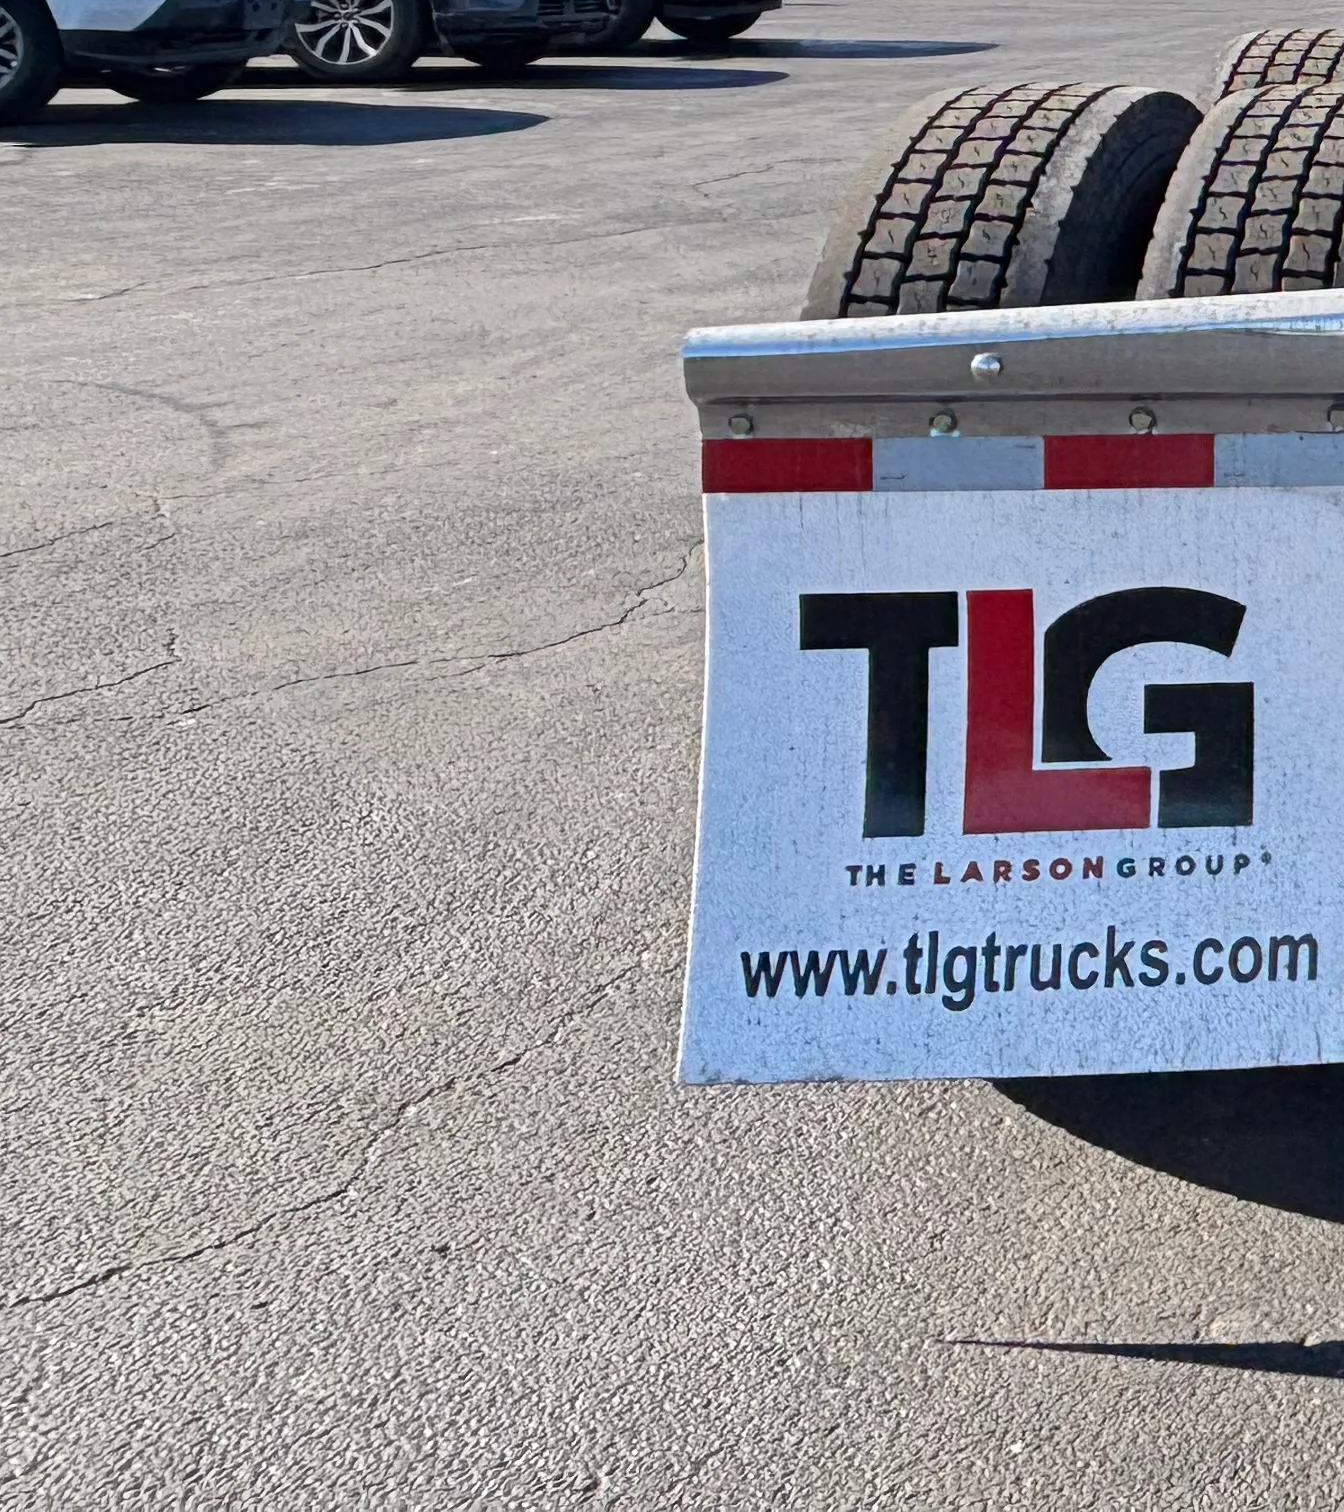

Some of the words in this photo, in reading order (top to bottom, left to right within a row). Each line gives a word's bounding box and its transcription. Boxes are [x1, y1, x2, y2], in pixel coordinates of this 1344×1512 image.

[799, 586, 1254, 838] TLG
[846, 862, 916, 886] THE
[933, 855, 1105, 884] LARSON
[740, 925, 1318, 1011] www.tlgtrucks.com
